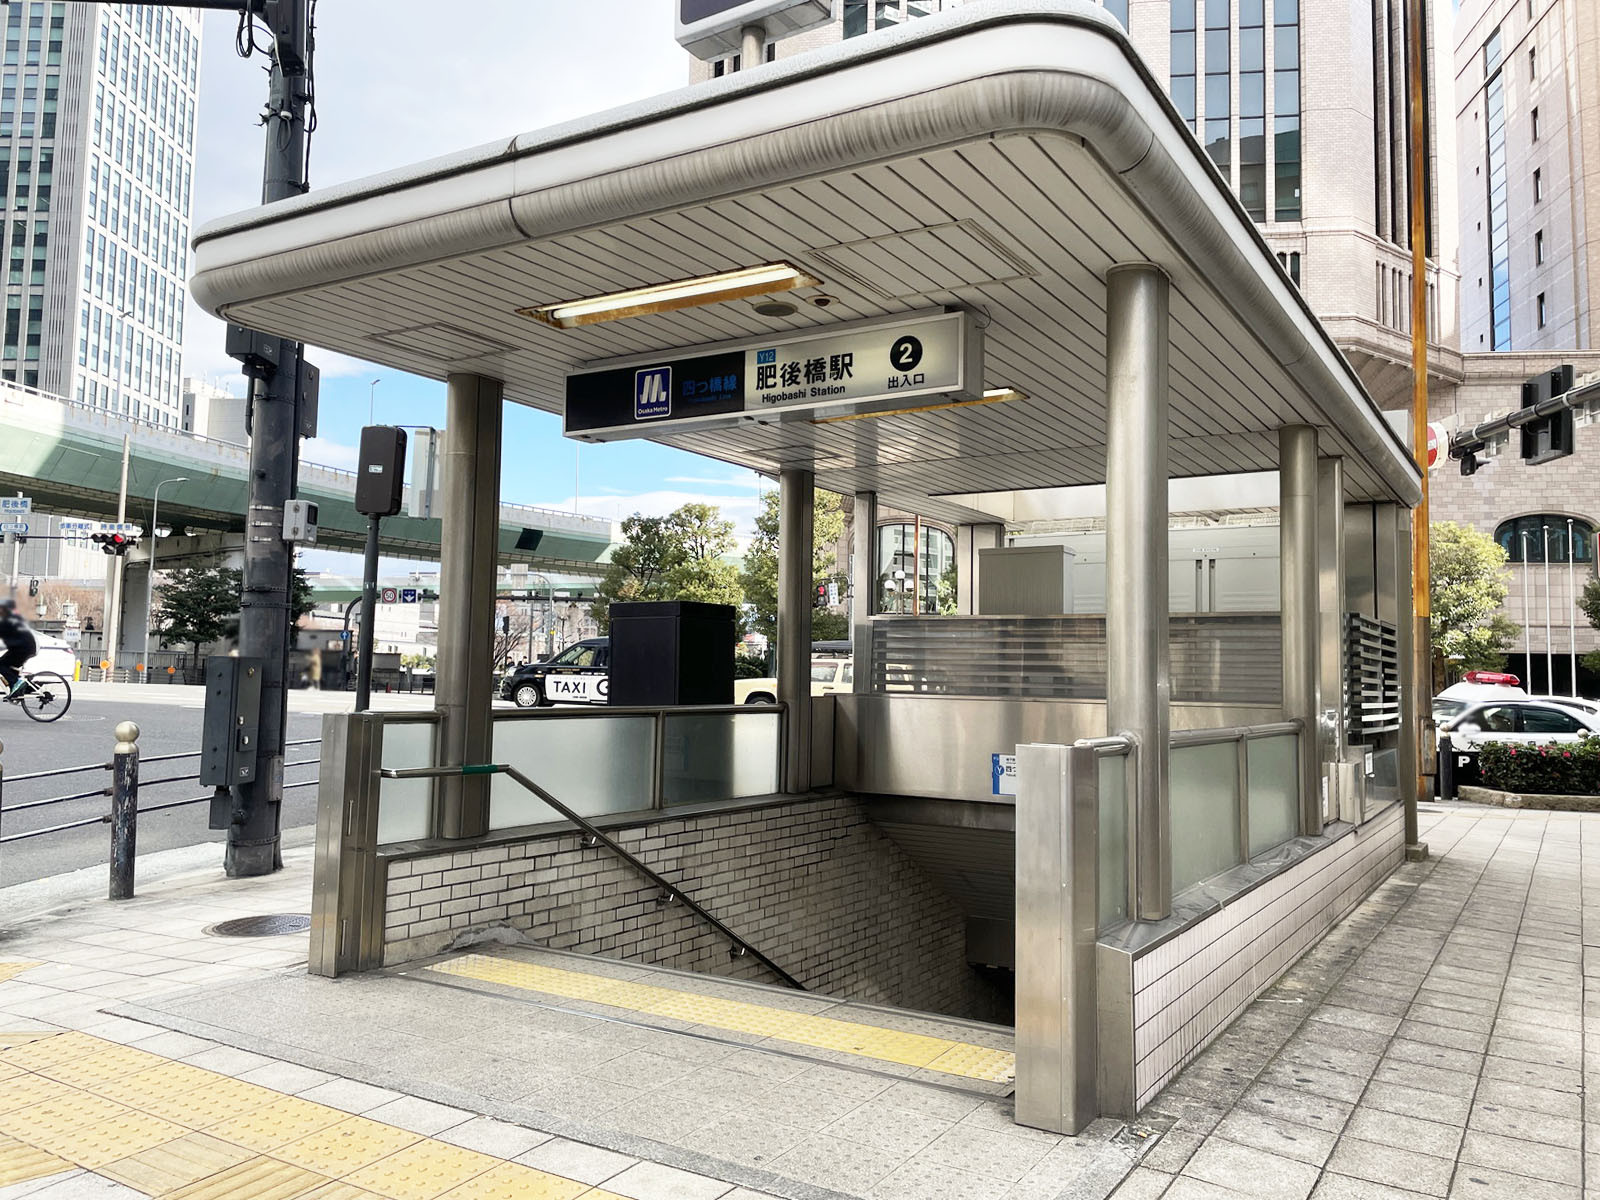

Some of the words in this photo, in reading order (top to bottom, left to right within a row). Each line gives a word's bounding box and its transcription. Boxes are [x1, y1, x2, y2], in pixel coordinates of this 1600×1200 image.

[759, 351, 775, 363] Y12
[899, 342, 913, 364] 2
[756, 352, 854, 391] 肥後橋駅
[682, 374, 738, 397] 四つ橋線
[887, 373, 925, 390] 出入口
[761, 388, 807, 404] Higobashi
[810, 384, 846, 398] Station
[637, 408, 653, 416] Osaka
[553, 681, 586, 694] TAXI
